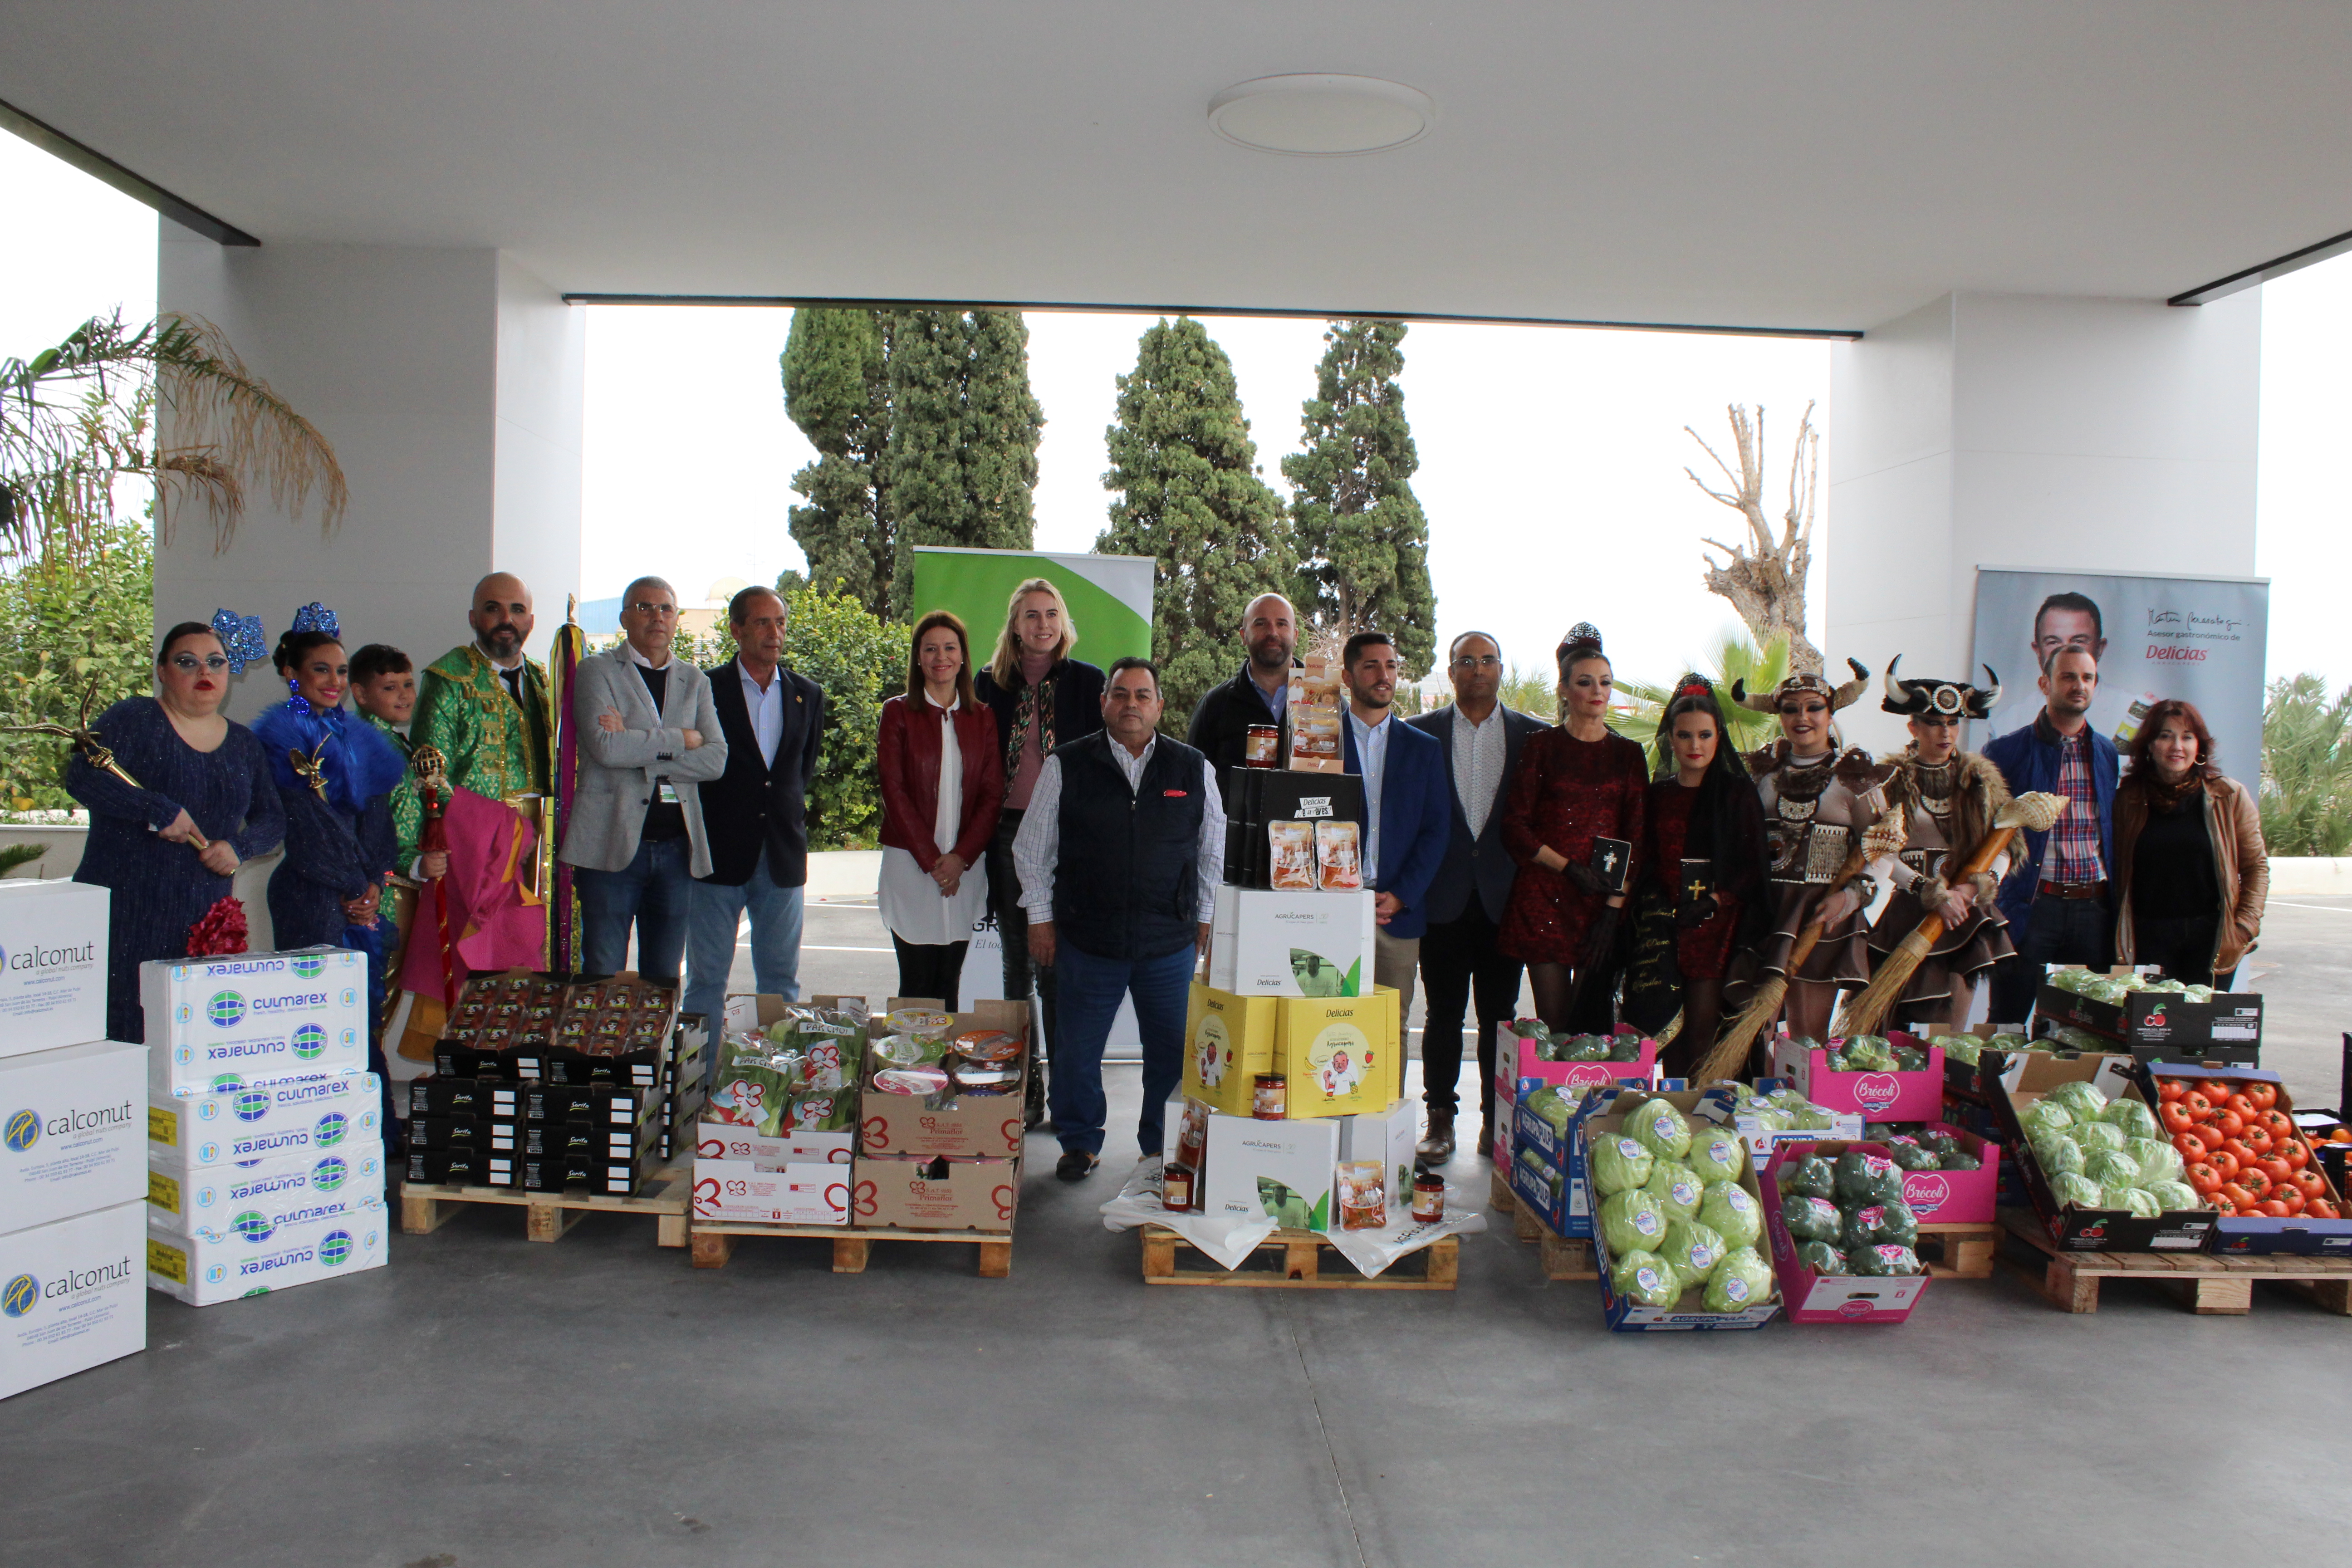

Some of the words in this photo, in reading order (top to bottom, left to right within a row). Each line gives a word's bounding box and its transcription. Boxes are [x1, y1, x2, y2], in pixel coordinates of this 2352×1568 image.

[2175, 632, 2228, 640] gastronómico
[2146, 645, 2208, 661] Delicias
[11, 941, 94, 970] calconut
[40, 966, 57, 976] global
[70, 963, 94, 971] company
[206, 960, 285, 977] culmarex
[253, 992, 328, 1009] culmarex
[1207, 998, 1225, 1011] Delicias
[1326, 1008, 1354, 1018] Delicias
[806, 1023, 825, 1032] PAK
[827, 1025, 848, 1035] CHOI
[207, 1041, 286, 1060] culmarex
[740, 1056, 757, 1064] PAK
[277, 1080, 350, 1102] culmarex
[1859, 1082, 1896, 1097] Brócoli
[47, 1100, 132, 1136] calconut
[78, 1128, 94, 1140] global
[108, 1122, 132, 1132] company
[233, 1133, 309, 1155] culmarex
[1242, 1140, 1281, 1149] AGRUCAPERS
[230, 1176, 306, 1200] culmarex
[1906, 1183, 1945, 1199] Brócoli
[274, 1202, 347, 1225] culmarex
[1225, 1203, 1249, 1212] Delicias
[239, 1250, 314, 1276] culmarex
[45, 1255, 131, 1298] calconut
[76, 1287, 93, 1300] global
[94, 1284, 107, 1293] nuts
[107, 1276, 131, 1289] company
[59, 1294, 102, 1313] www.calconut.com
